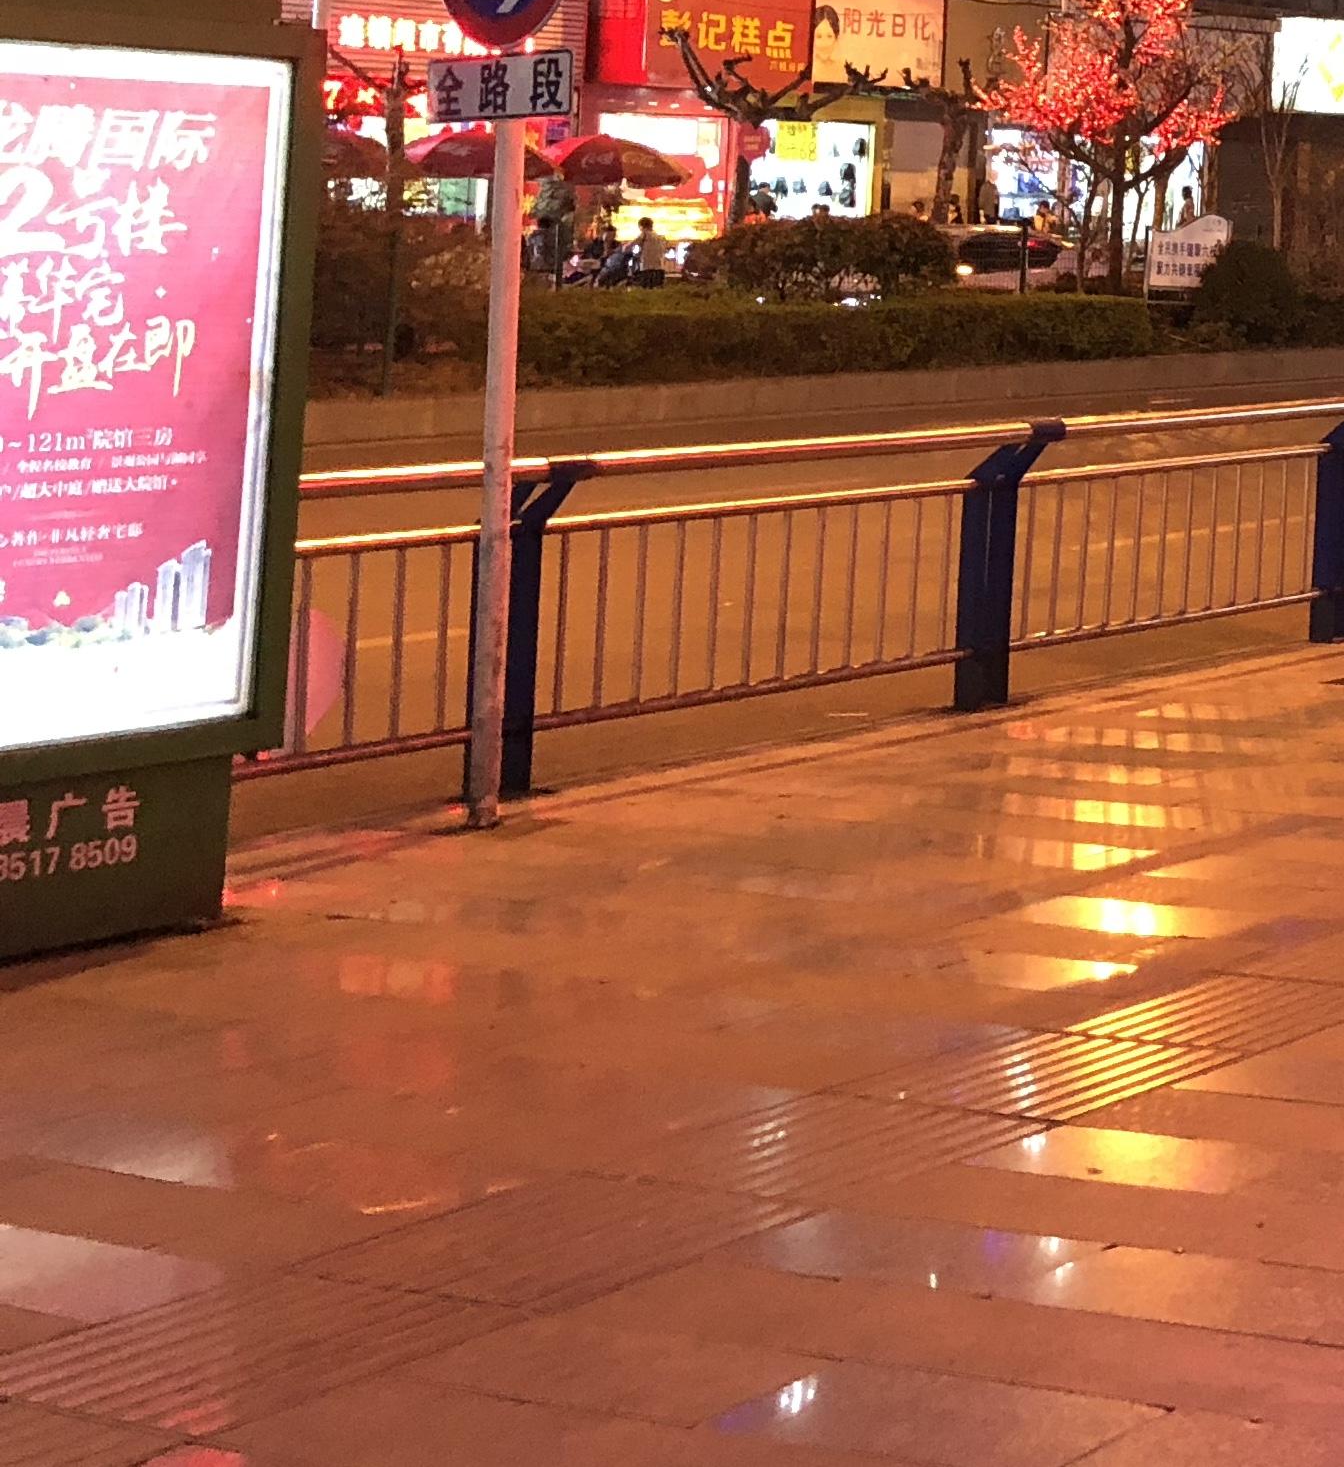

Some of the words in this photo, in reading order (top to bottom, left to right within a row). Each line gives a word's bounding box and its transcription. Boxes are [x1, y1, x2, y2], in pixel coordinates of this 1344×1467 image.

[842, 7, 938, 42] 阳光日化
[435, 55, 564, 117] 全路段
[69, 834, 138, 871] 8509
